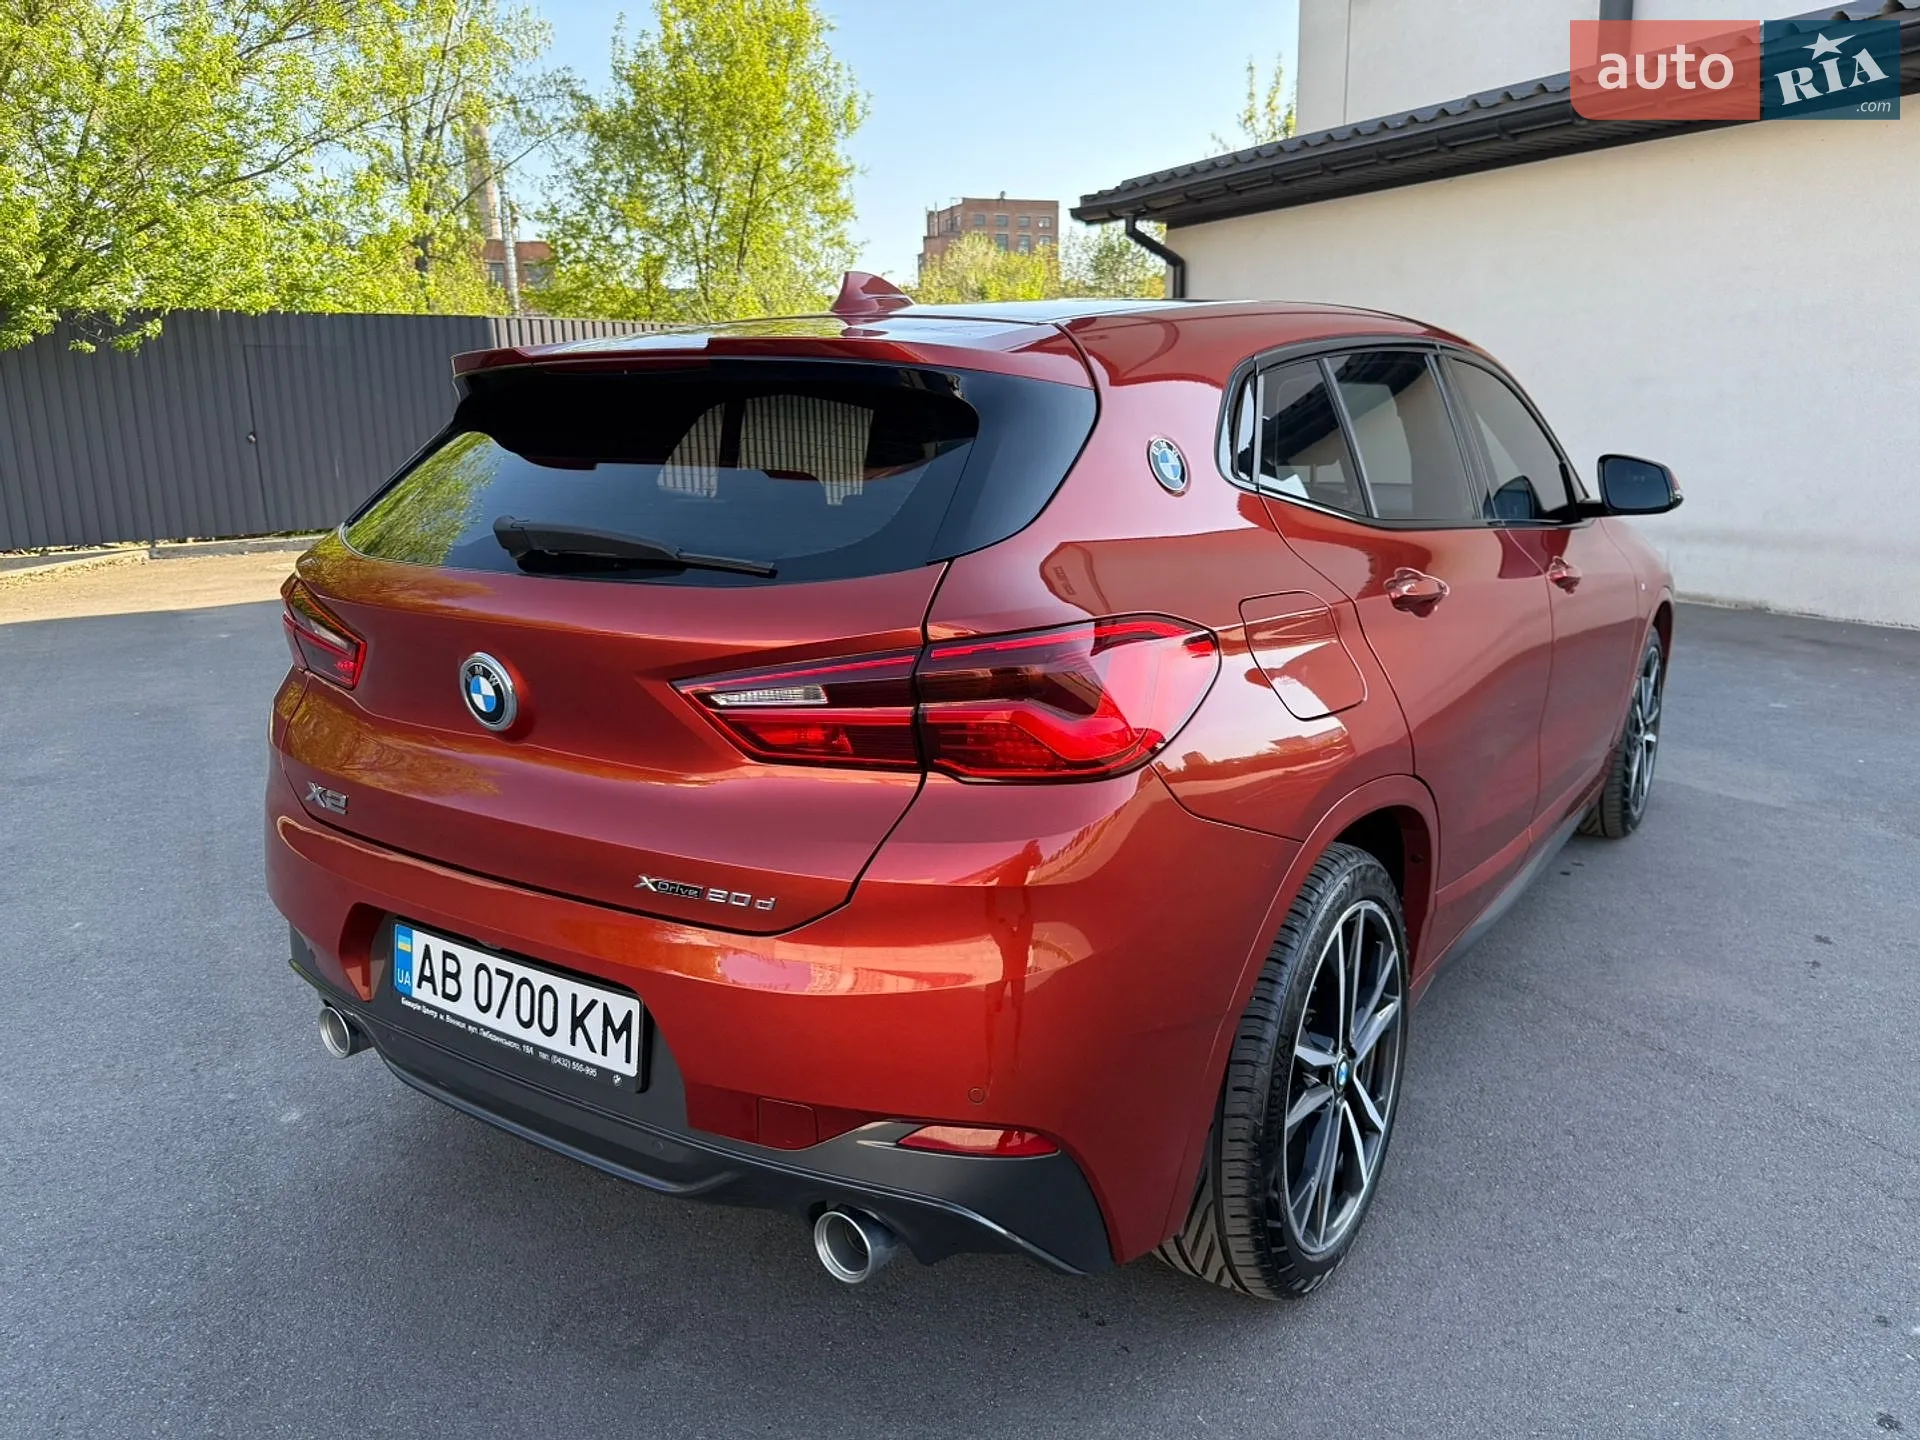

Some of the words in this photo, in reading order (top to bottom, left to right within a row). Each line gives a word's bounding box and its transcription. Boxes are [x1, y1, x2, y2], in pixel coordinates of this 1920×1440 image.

[466, 665, 500, 687] BMW
[304, 781, 349, 816] X2
[396, 967, 412, 987] UA
[416, 943, 463, 1004] AB
[474, 962, 559, 1038] 0700
[569, 992, 633, 1065] KM
